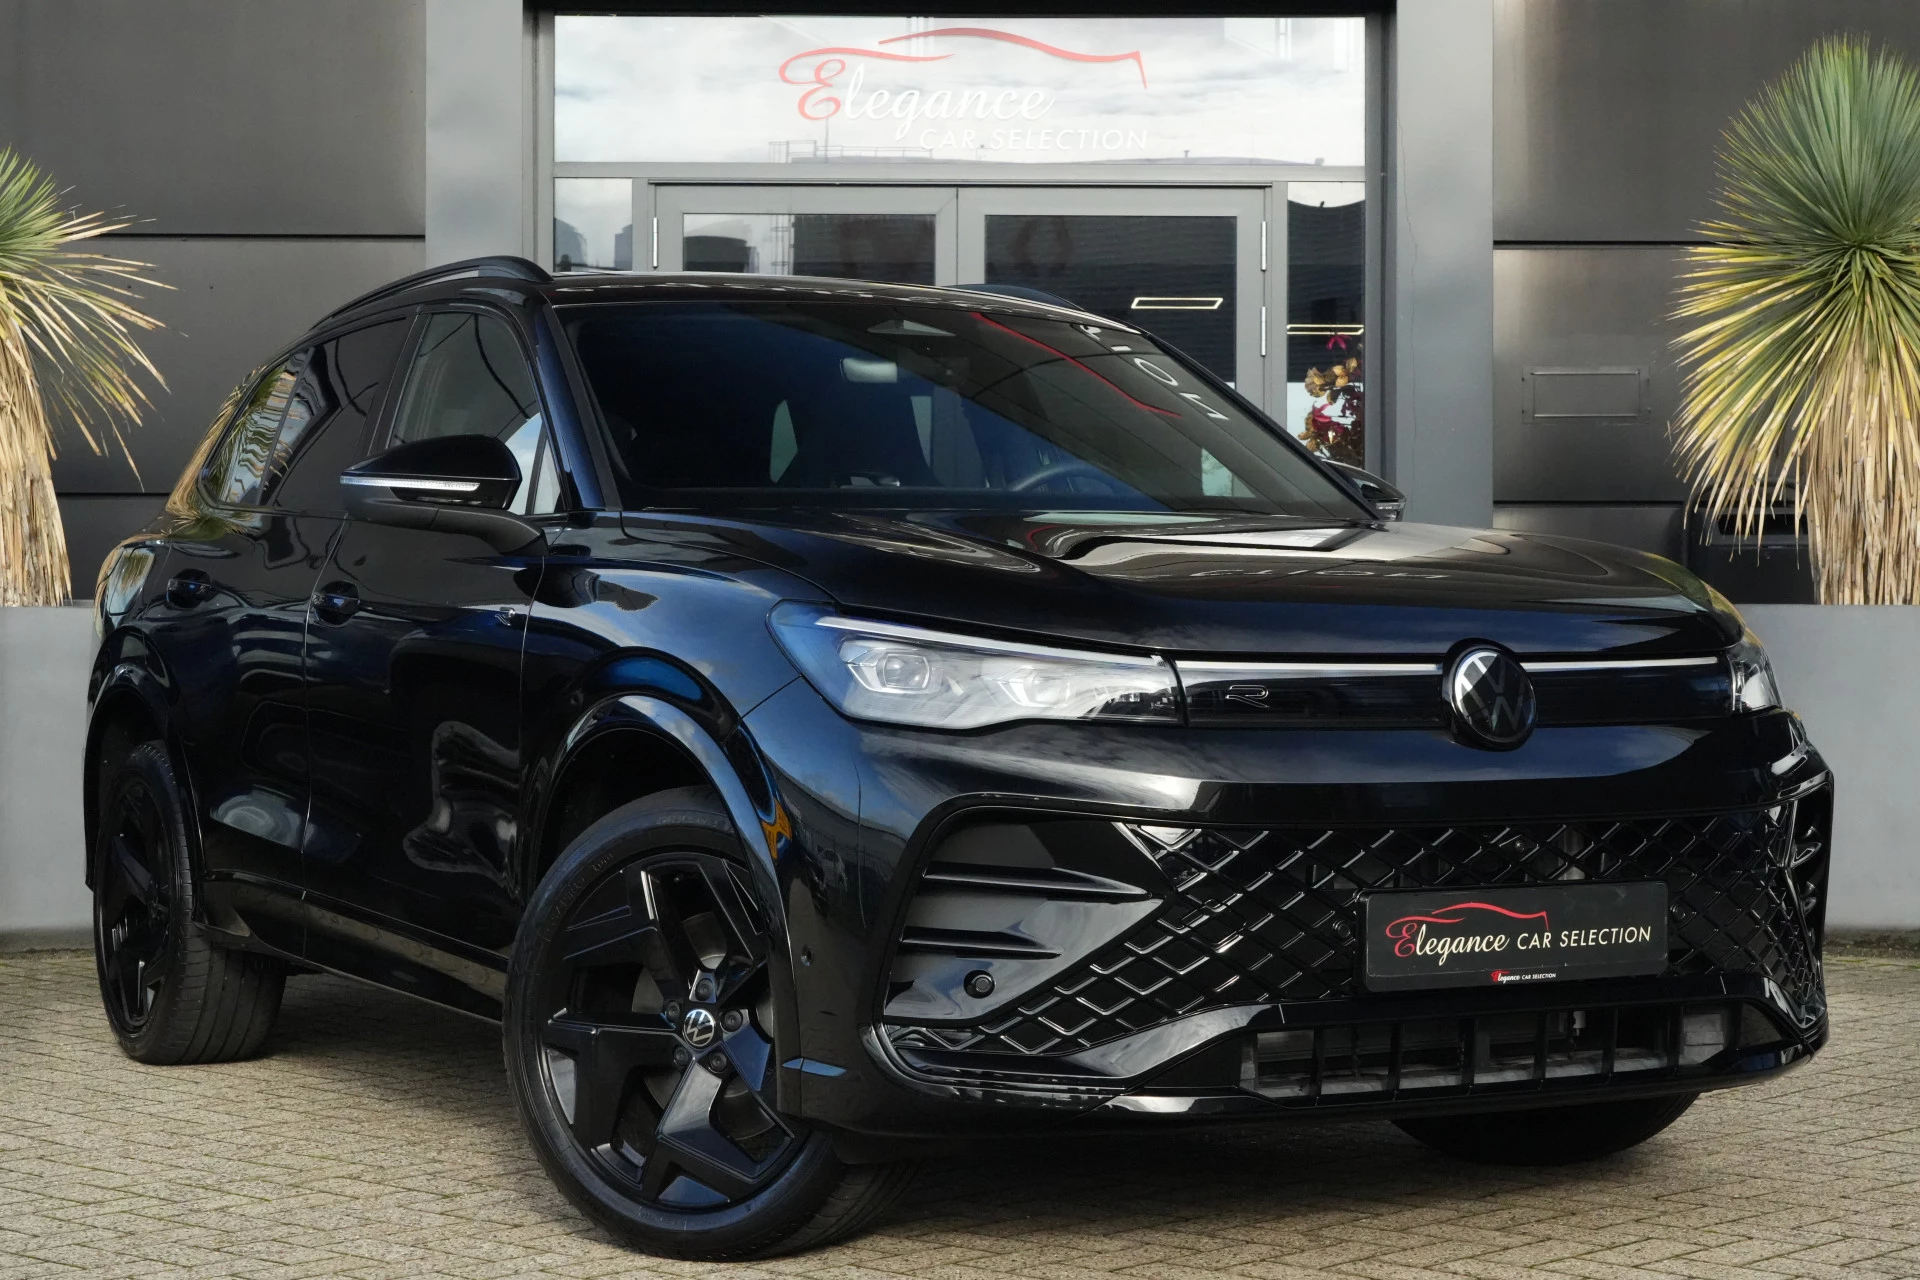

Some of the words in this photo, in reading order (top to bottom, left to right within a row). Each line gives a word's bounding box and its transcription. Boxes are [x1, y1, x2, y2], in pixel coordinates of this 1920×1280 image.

[778, 47, 1055, 141] Elegance
[920, 128, 976, 151] CAR
[990, 128, 1148, 152] SELECTION
[1385, 916, 1510, 967] Elegance
[1517, 932, 1552, 950] CAR
[1559, 925, 1651, 948] SELECTION
